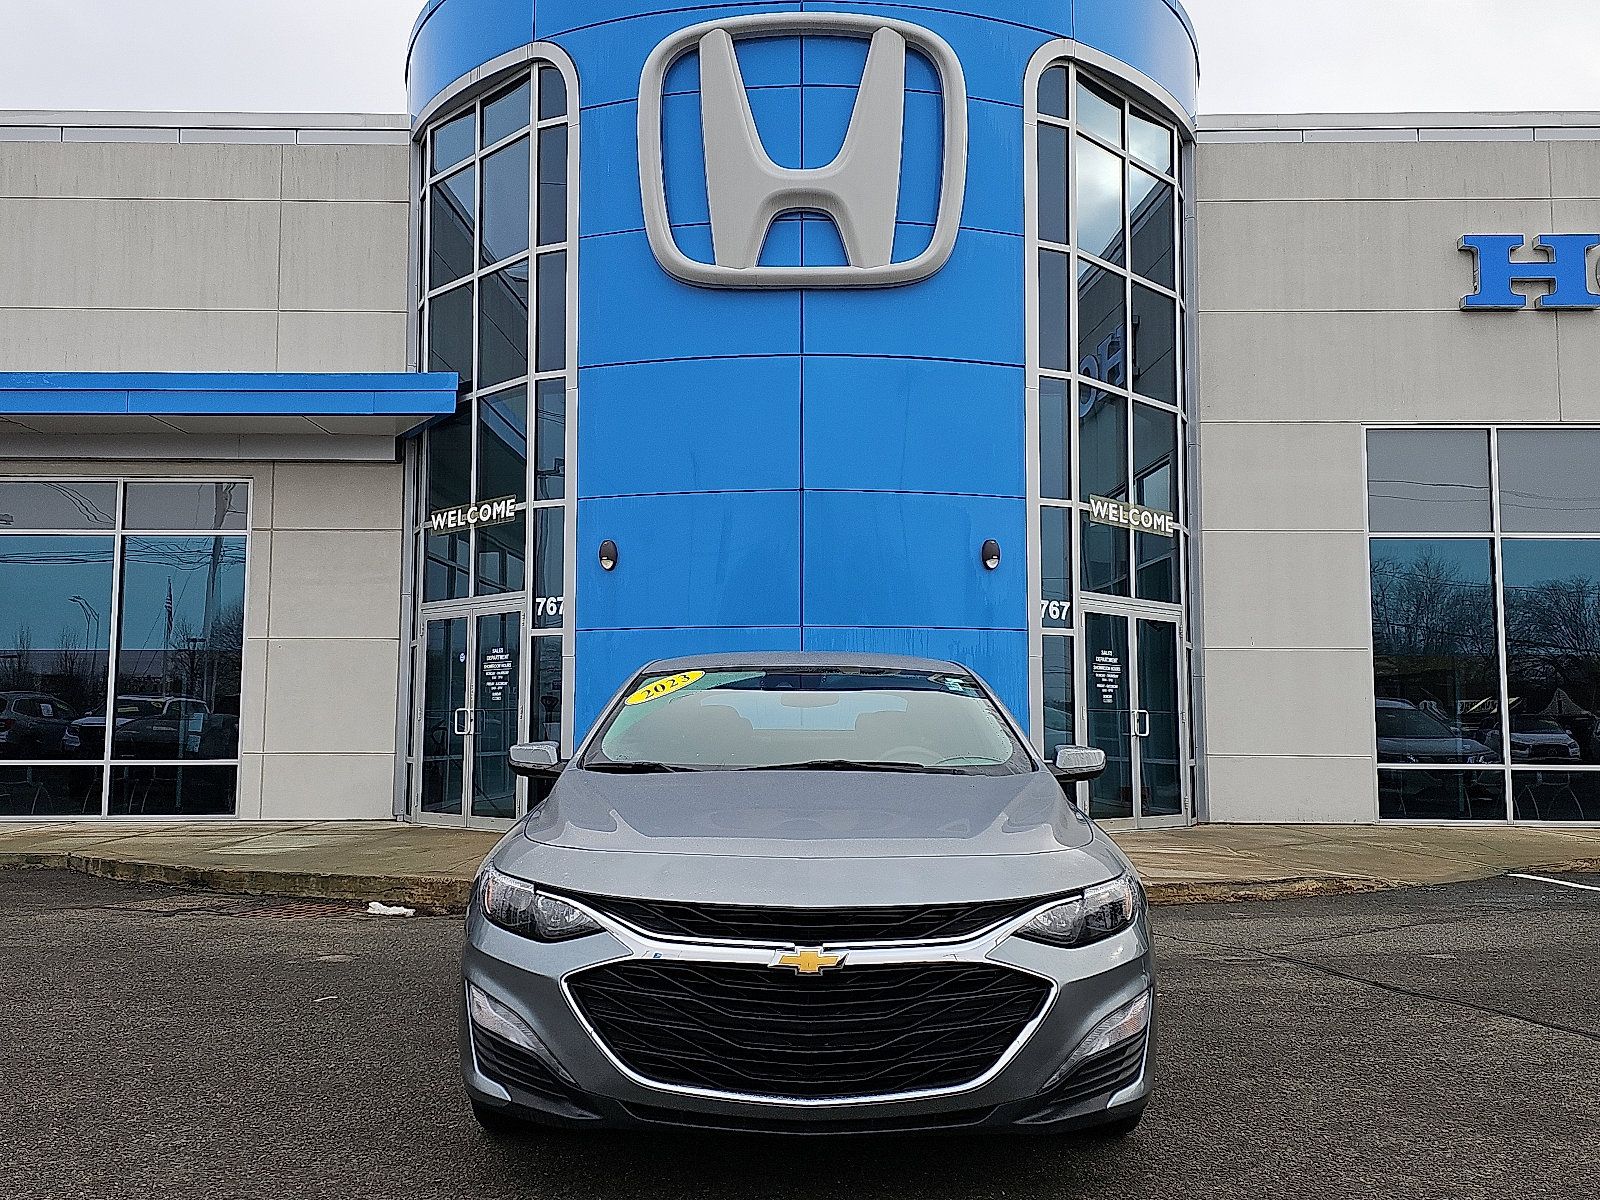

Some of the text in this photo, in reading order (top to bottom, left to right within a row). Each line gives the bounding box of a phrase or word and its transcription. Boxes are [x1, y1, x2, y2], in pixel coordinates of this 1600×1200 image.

[1457, 233, 1600, 311] H
[431, 499, 516, 531] WELCOME
[1089, 498, 1174, 533] WELCOME
[1040, 600, 1071, 621] 767
[640, 674, 691, 699] 2023
